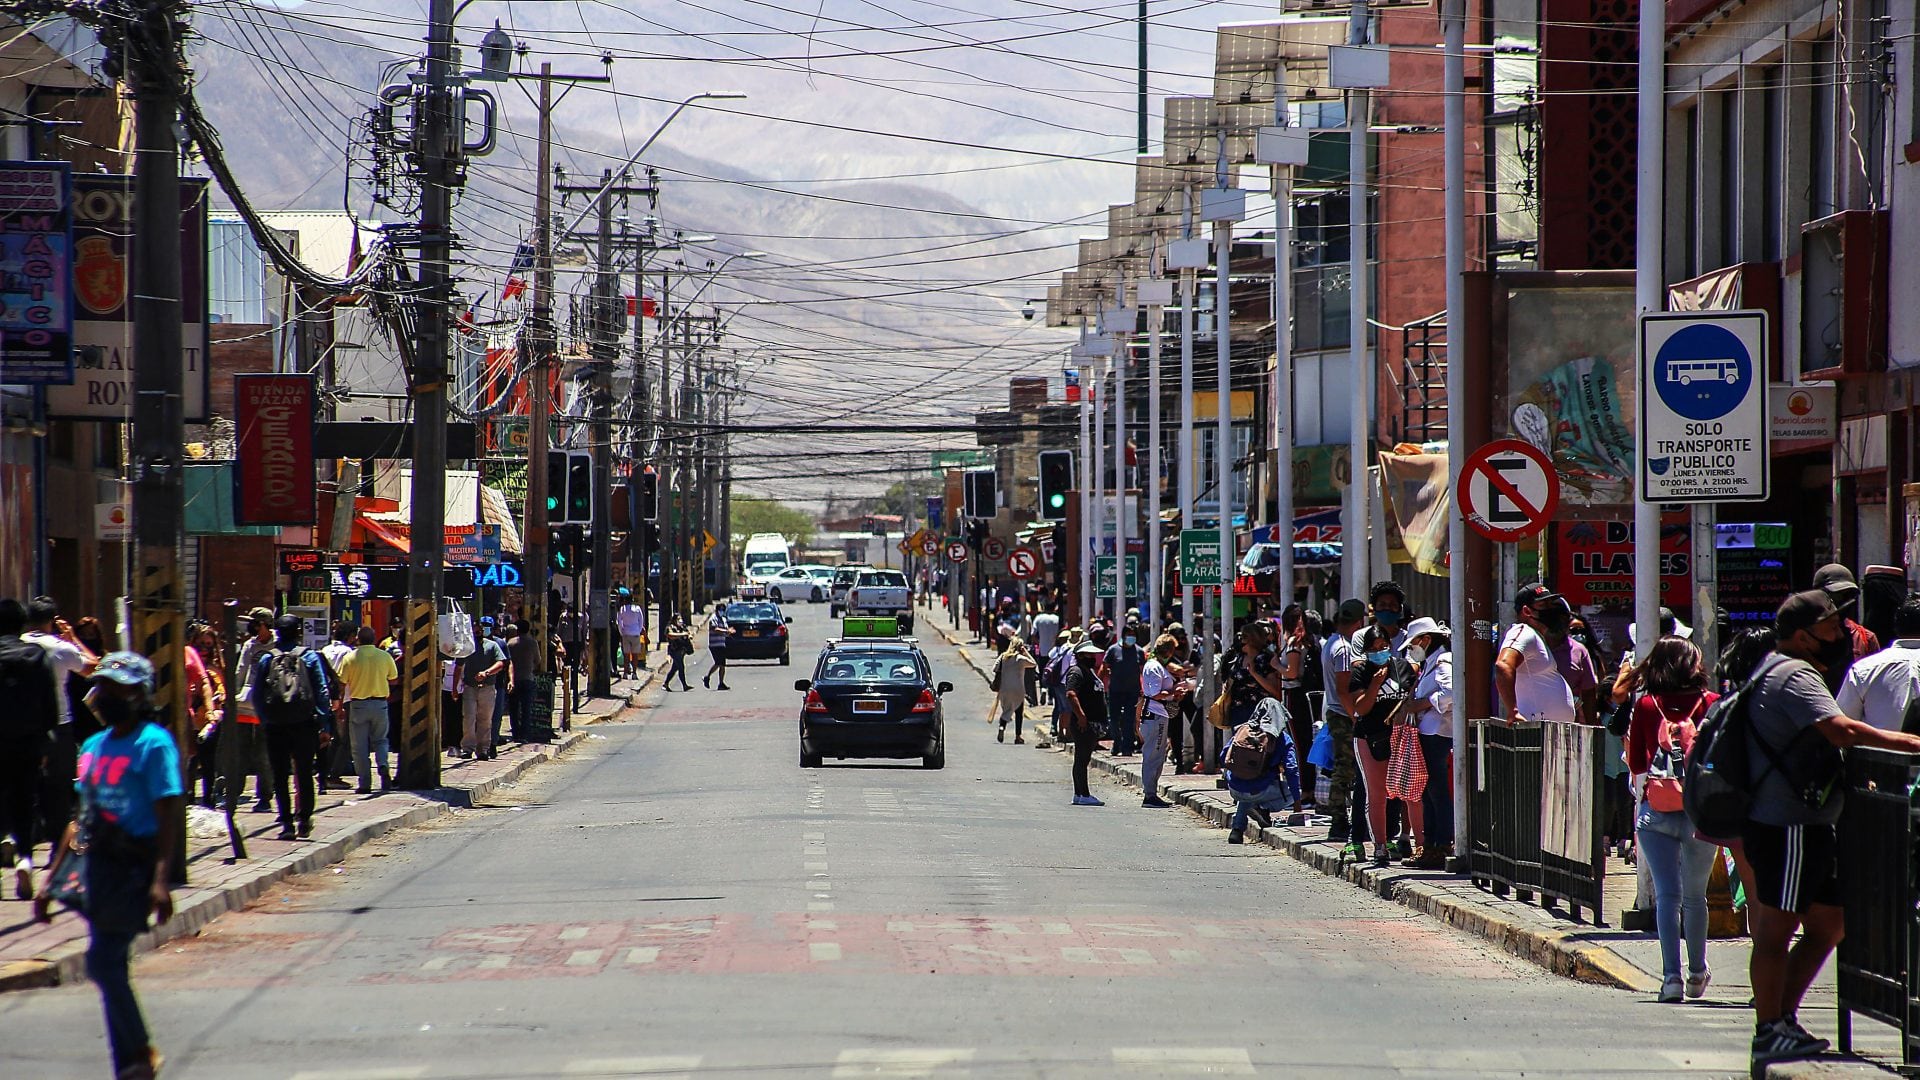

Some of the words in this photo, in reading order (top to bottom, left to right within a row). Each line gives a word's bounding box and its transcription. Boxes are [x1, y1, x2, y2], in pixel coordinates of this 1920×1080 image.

[73, 190, 136, 221] ROY
[87, 380, 136, 406] ROY
[248, 385, 305, 396] TIENDA
[250, 396, 303, 405] BAZAR
[1685, 423, 1723, 436] SOLO
[1657, 439, 1752, 453] TRANSPORTE
[258, 406, 297, 507] GERARDO
[1673, 455, 1735, 469] PUBLICO
[1488, 459, 1531, 522] E
[1758, 526, 1788, 545] 800
[1573, 552, 1690, 575] LLAES
[1185, 567, 1221, 577] PARAD
[1099, 584, 1134, 593] PARDA
